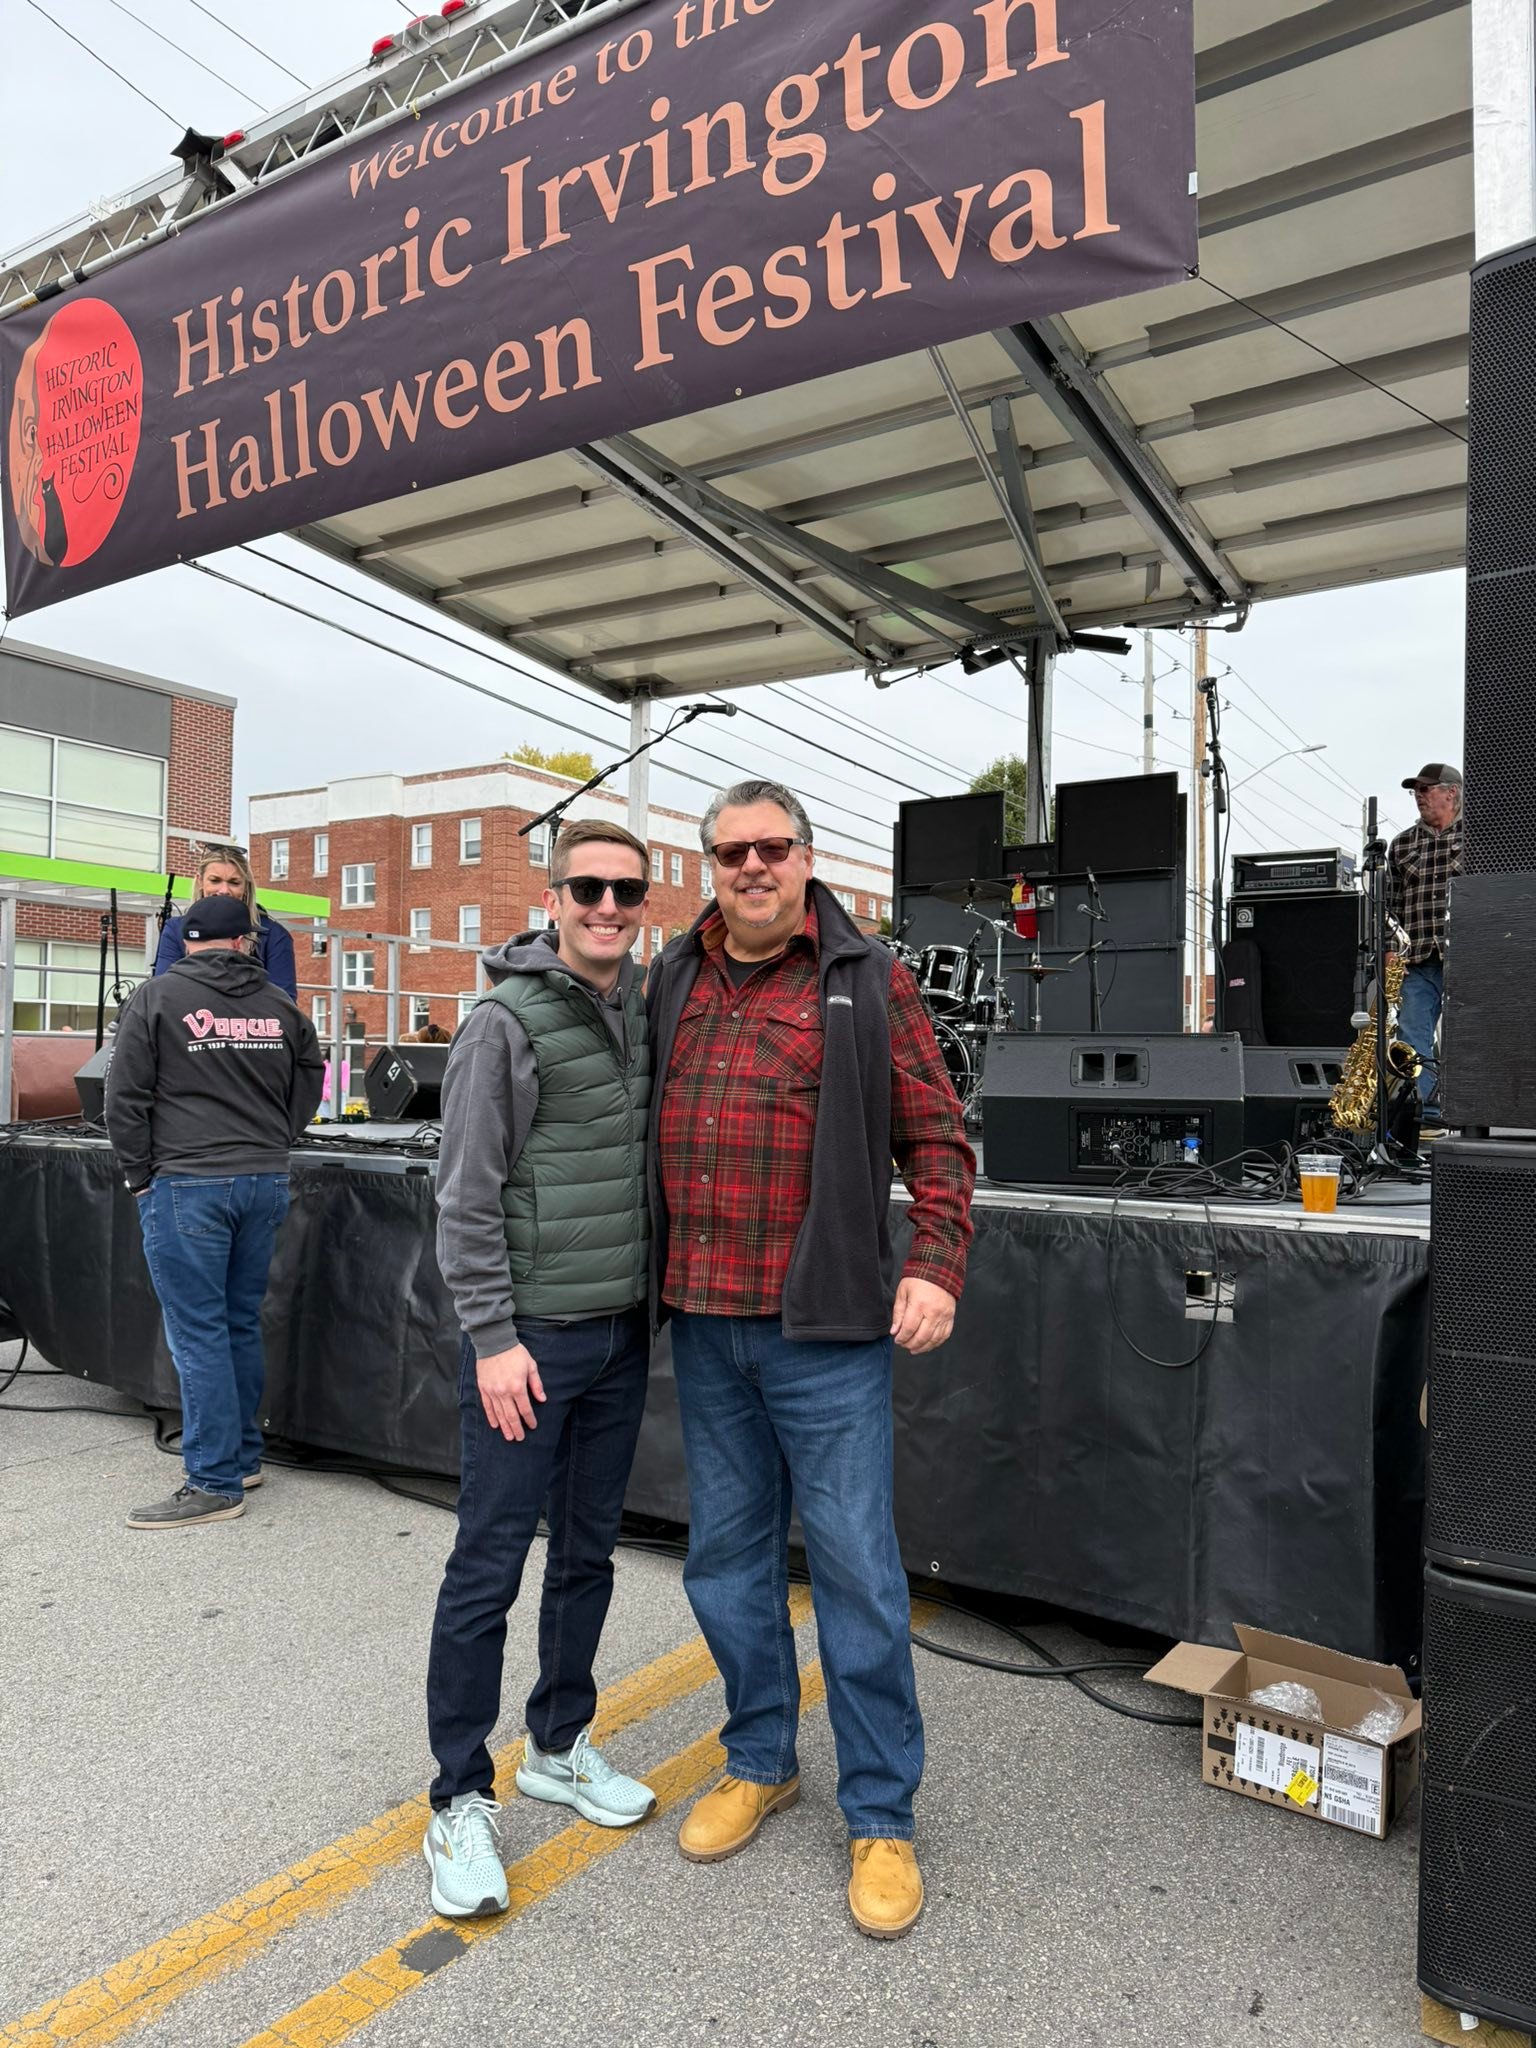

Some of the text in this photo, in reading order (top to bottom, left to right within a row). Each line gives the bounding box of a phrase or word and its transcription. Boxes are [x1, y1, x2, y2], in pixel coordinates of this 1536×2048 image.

[348, 64, 577, 199] Welcome
[596, 29, 653, 84] to
[171, 0, 1070, 398] Historic Irvington
[171, 99, 1120, 520] Halloween Festival
[45, 342, 117, 392] HISTORIC
[52, 363, 135, 422] IRVINGTON
[46, 392, 138, 457] HALLOWEEN
[60, 431, 130, 484] FESTIVAL
[188, 1044, 205, 1052] EST.
